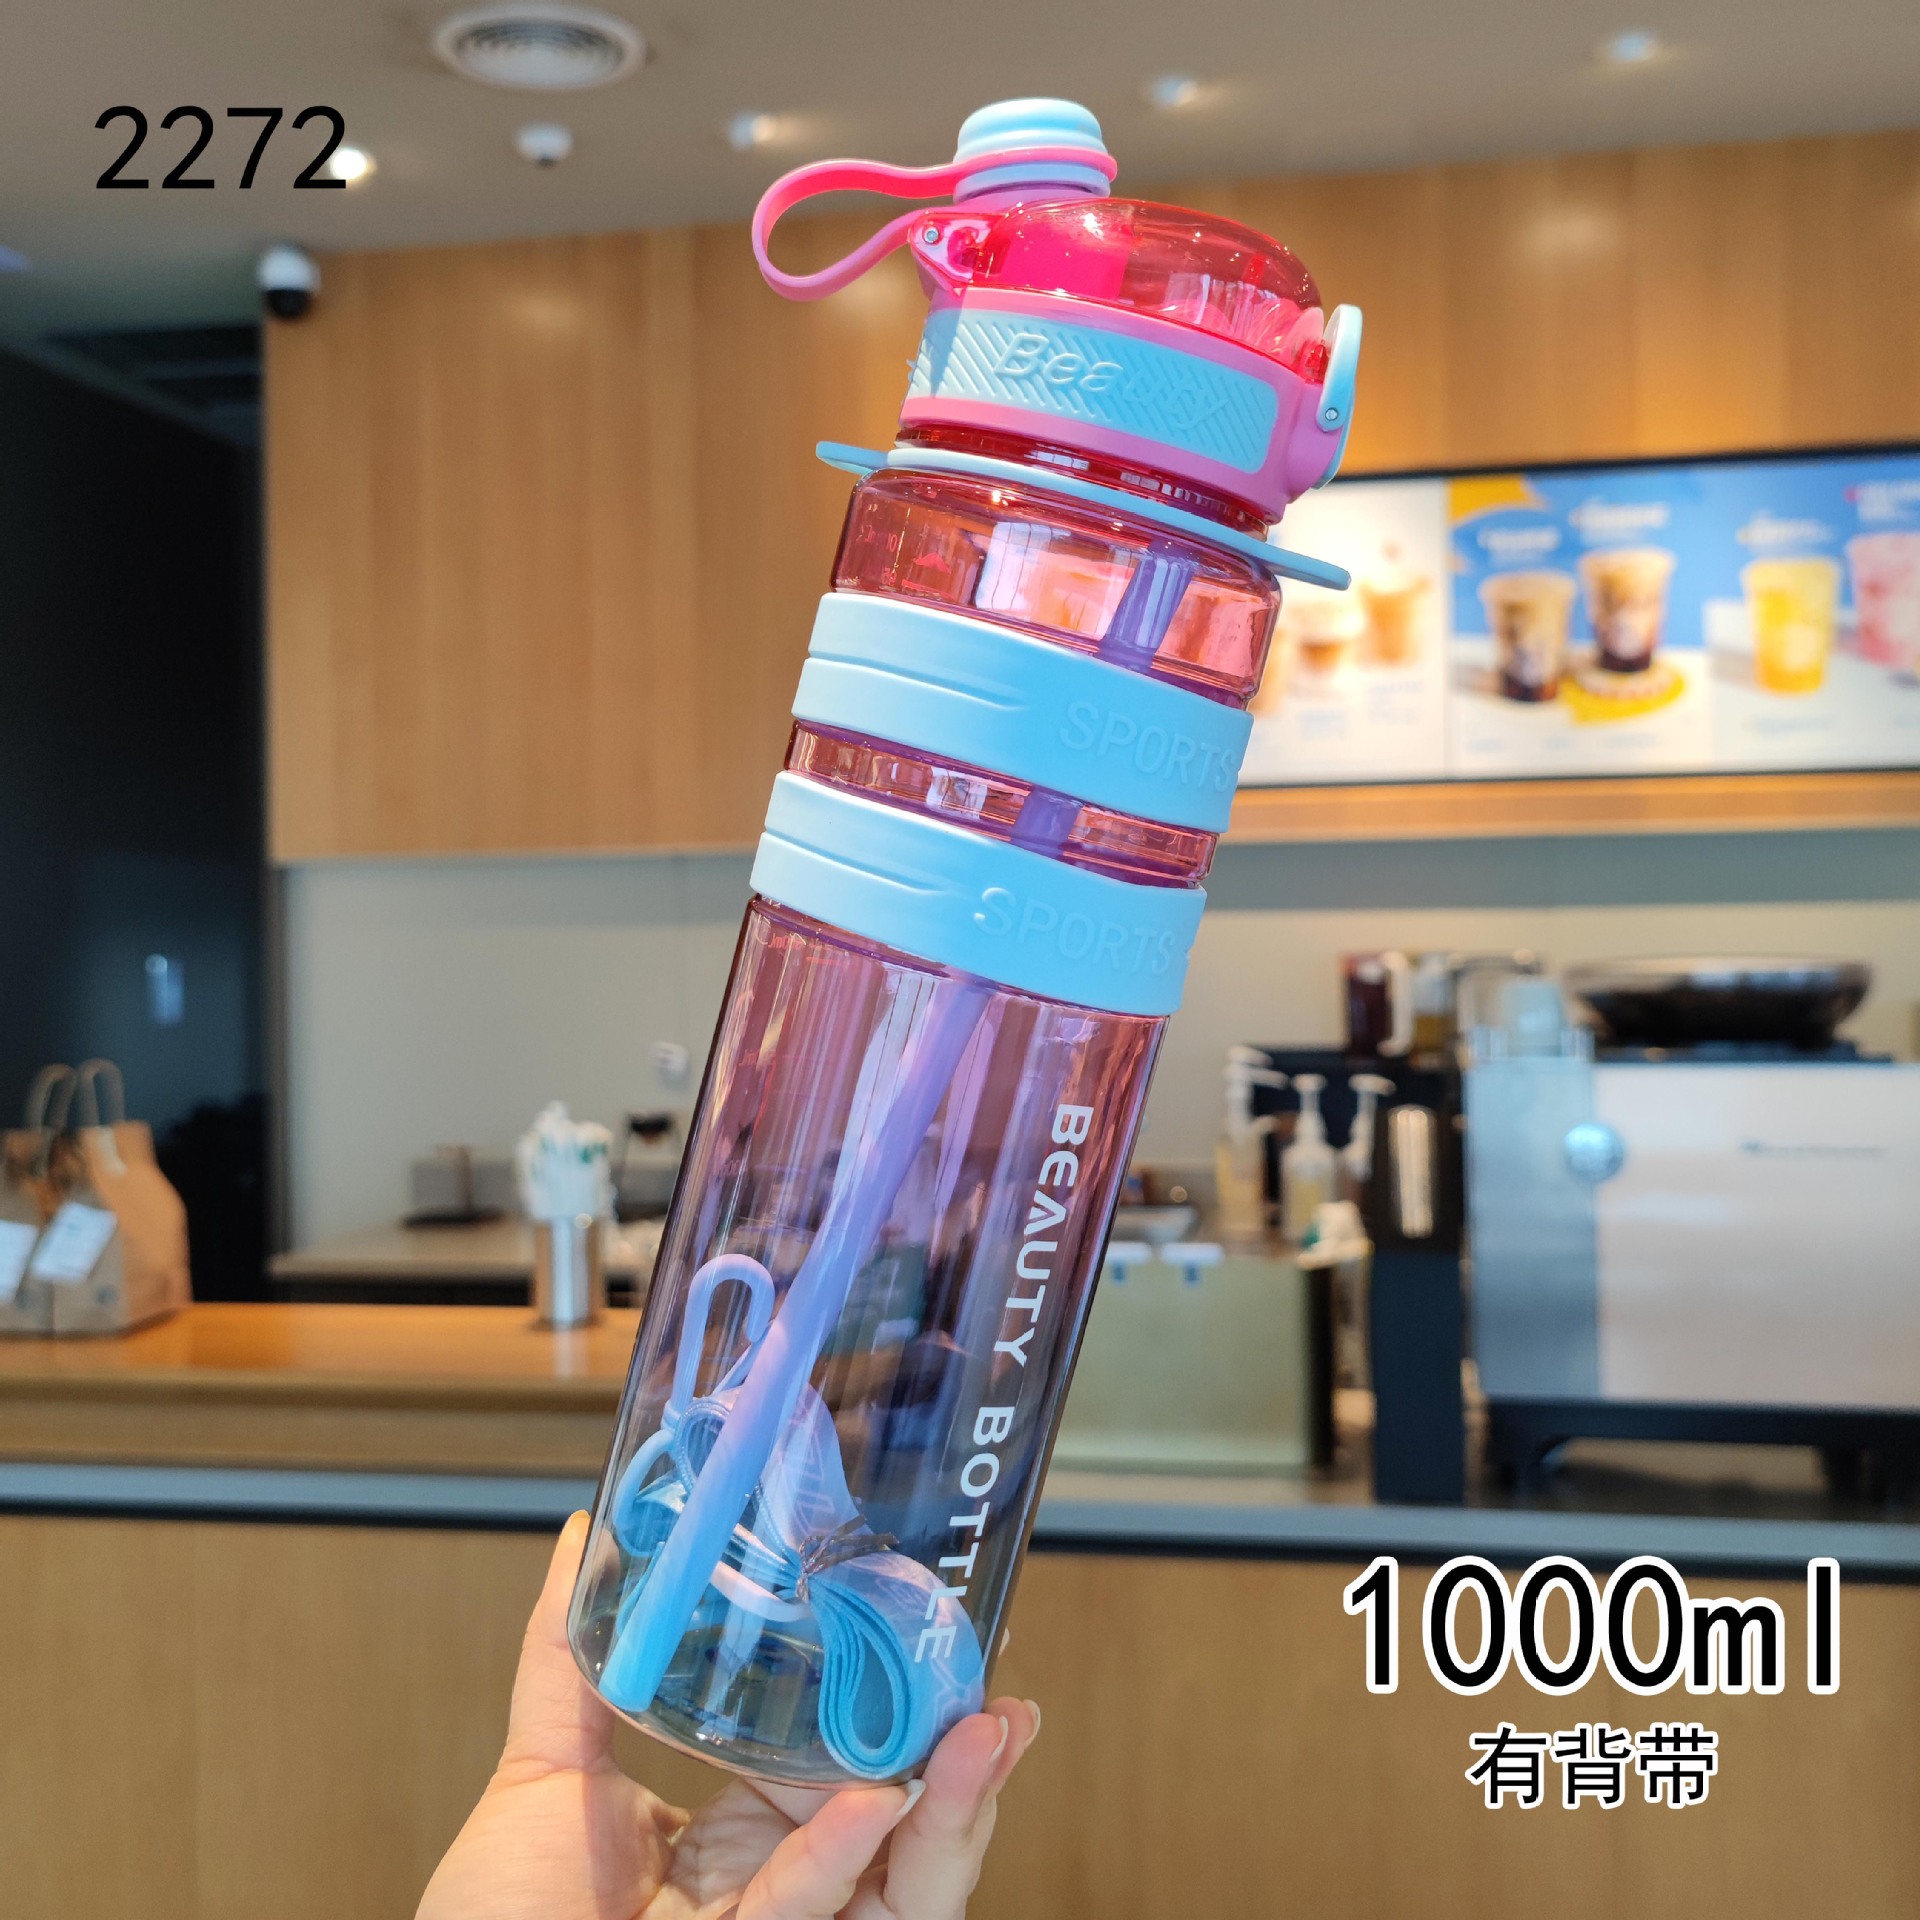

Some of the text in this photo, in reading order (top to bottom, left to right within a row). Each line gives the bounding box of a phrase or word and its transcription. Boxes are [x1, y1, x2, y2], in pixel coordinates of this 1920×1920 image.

[1058, 701, 1240, 794] SPORTS
[973, 887, 1178, 975] SPORTS
[915, 1103, 1094, 1662] BEAUTY BOTTLE
